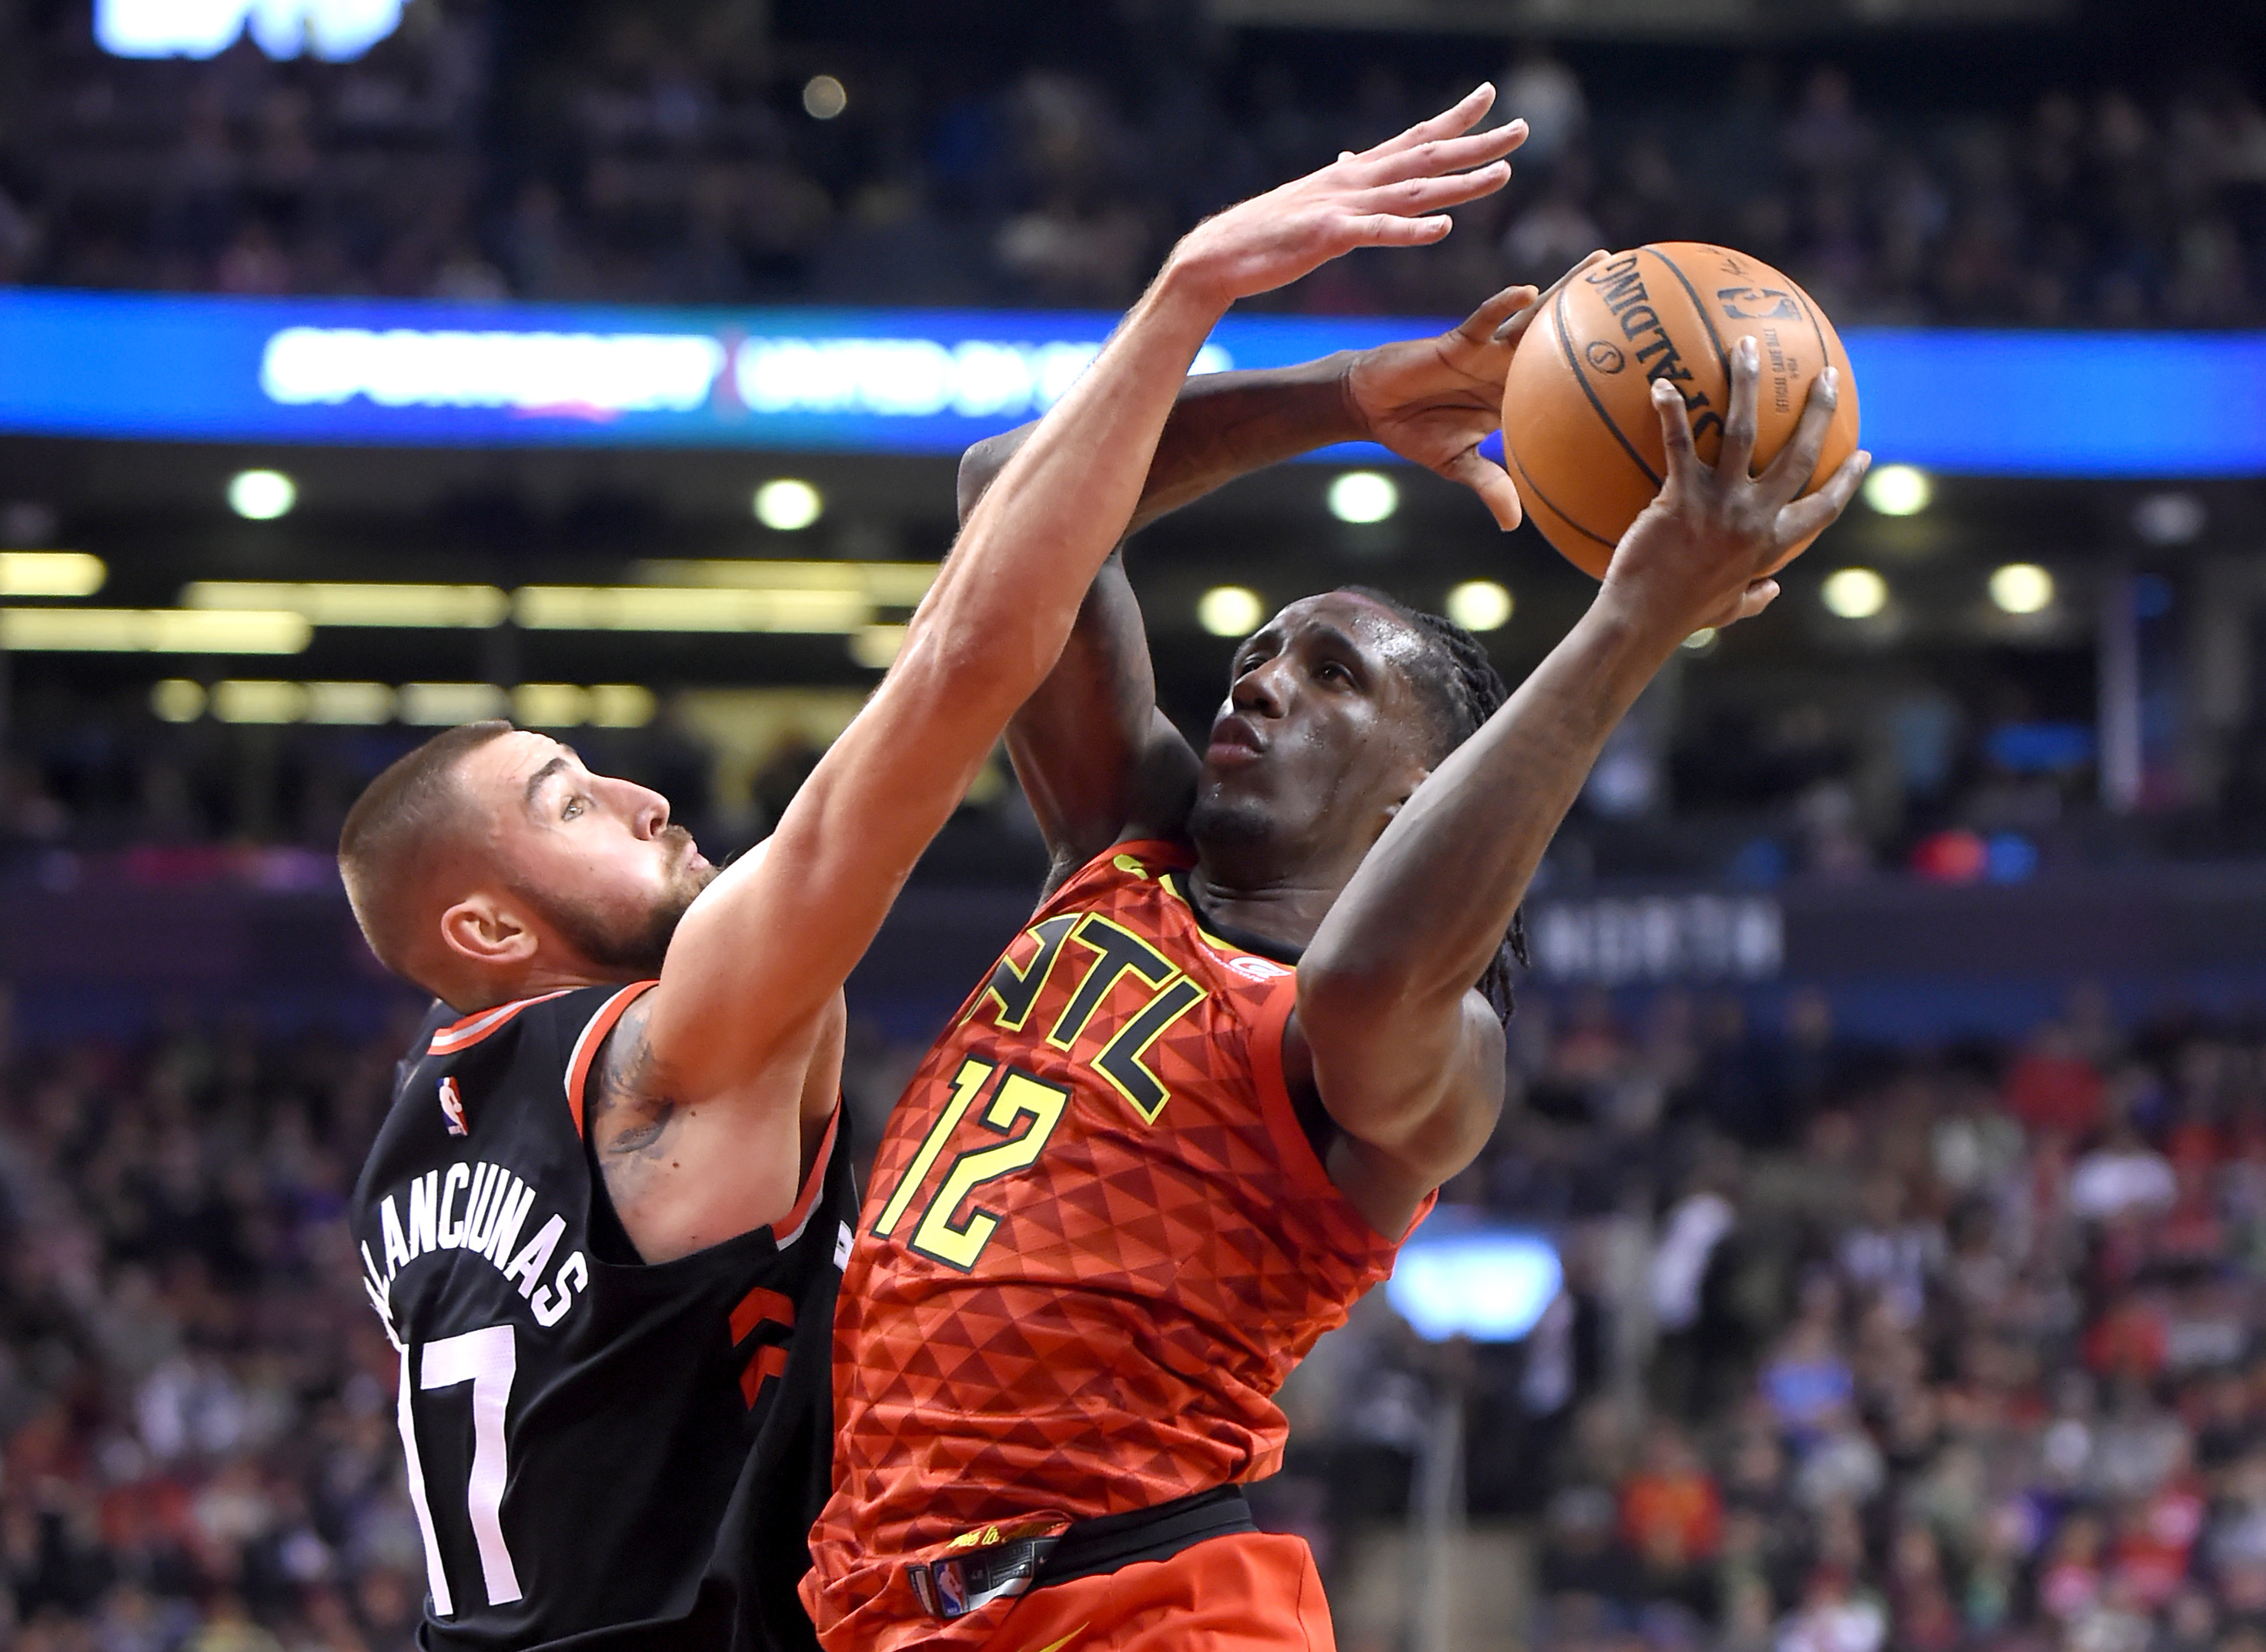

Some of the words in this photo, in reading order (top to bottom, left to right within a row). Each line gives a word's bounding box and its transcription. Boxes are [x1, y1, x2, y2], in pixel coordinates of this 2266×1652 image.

[959, 911, 1209, 1126] ATL
[362, 1161, 589, 1353] LANCIUNAS
[869, 1052, 1073, 1275] 12
[398, 1325, 523, 1617] 17
